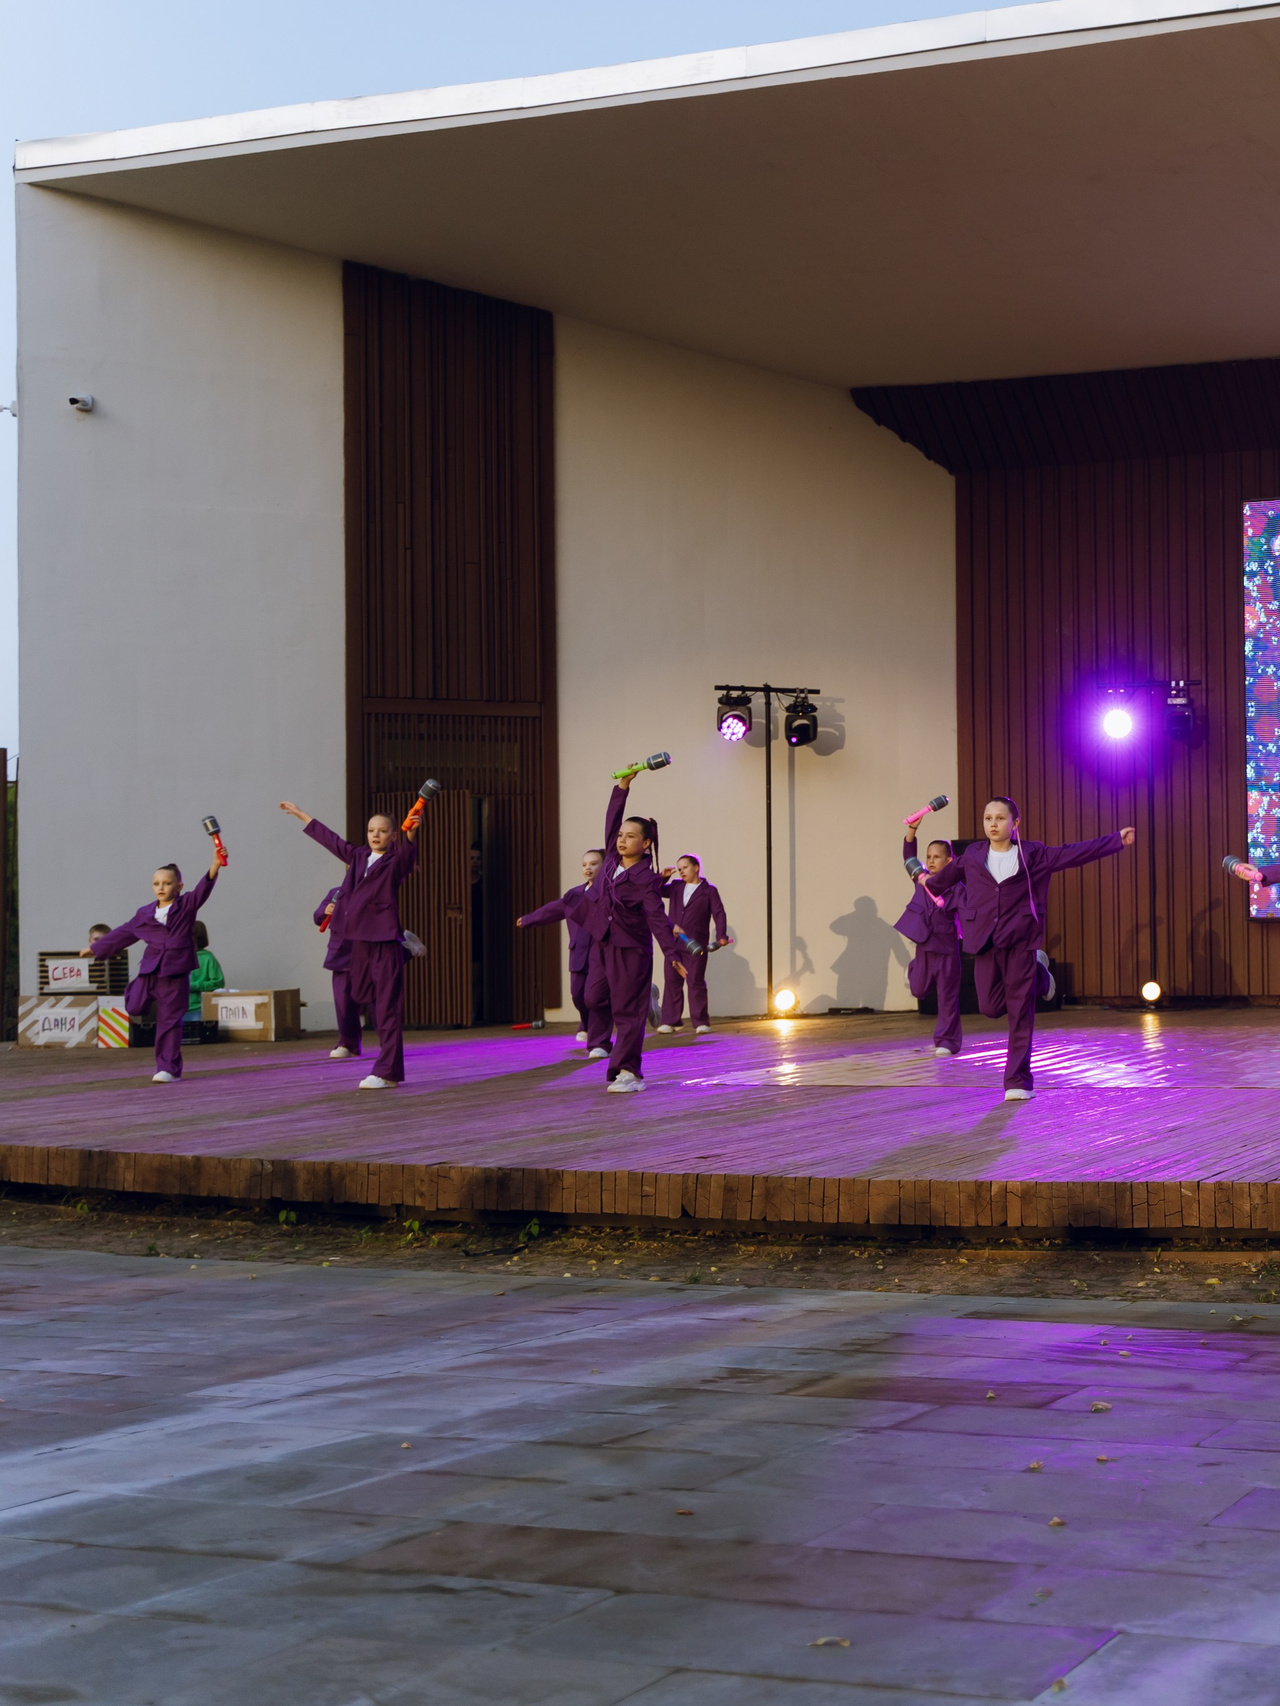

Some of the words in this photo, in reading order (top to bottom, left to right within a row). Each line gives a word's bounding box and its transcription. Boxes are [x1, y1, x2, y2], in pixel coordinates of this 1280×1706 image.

[51, 966, 82, 981] СЕВА
[220, 1005, 248, 1020] ПАПА
[41, 1016, 76, 1032] ДАНЯ
